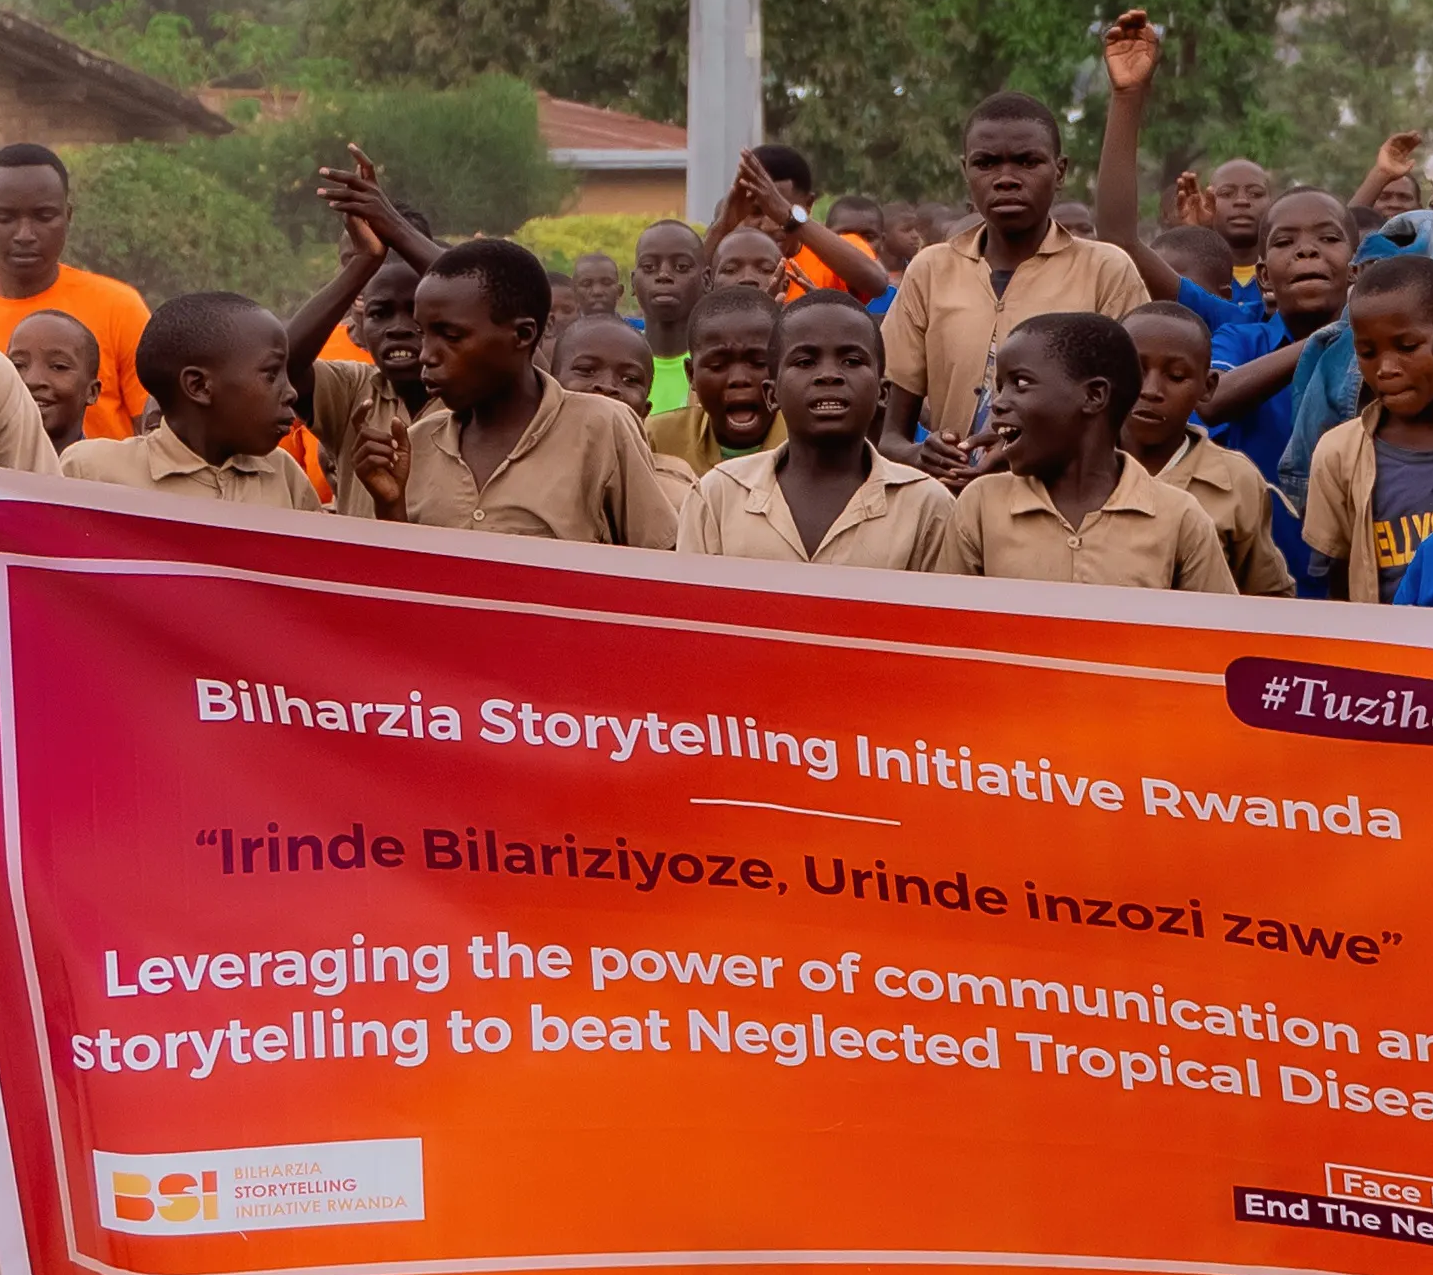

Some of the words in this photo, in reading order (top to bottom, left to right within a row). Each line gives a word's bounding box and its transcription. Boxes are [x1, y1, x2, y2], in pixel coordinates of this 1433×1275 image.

[196, 677, 462, 742] Bilharzia
[479, 698, 839, 782] Storytelling
[856, 733, 1124, 814] Initiative
[1142, 775, 1404, 842] Rwanda
[195, 822, 406, 875] “Irinde
[423, 827, 789, 897] Bilariziyoze,
[803, 854, 1009, 917] Urinde
[1026, 880, 1206, 940] inzozi
[1223, 910, 1405, 967] zawe”
[104, 932, 452, 997] Leveraging
[468, 932, 573, 981] the
[590, 941, 783, 991] power
[799, 951, 862, 995] of
[874, 964, 1362, 1055] communication
[71, 1006, 429, 1080] storytelling
[447, 1009, 512, 1053] to
[530, 1003, 672, 1053] beat
[689, 1005, 1001, 1069] Neglected
[1016, 1029, 1261, 1099] Tropical
[233, 1161, 323, 1180] BILHARZIA
[234, 1178, 358, 1200] STORYTELLING
[1343, 1172, 1421, 1204] Face
[112, 1170, 219, 1223] BSI
[235, 1198, 322, 1219] INITIATIVE
[327, 1194, 408, 1213] RWANDA
[1245, 1192, 1310, 1221] End
[1318, 1202, 1382, 1231] The
